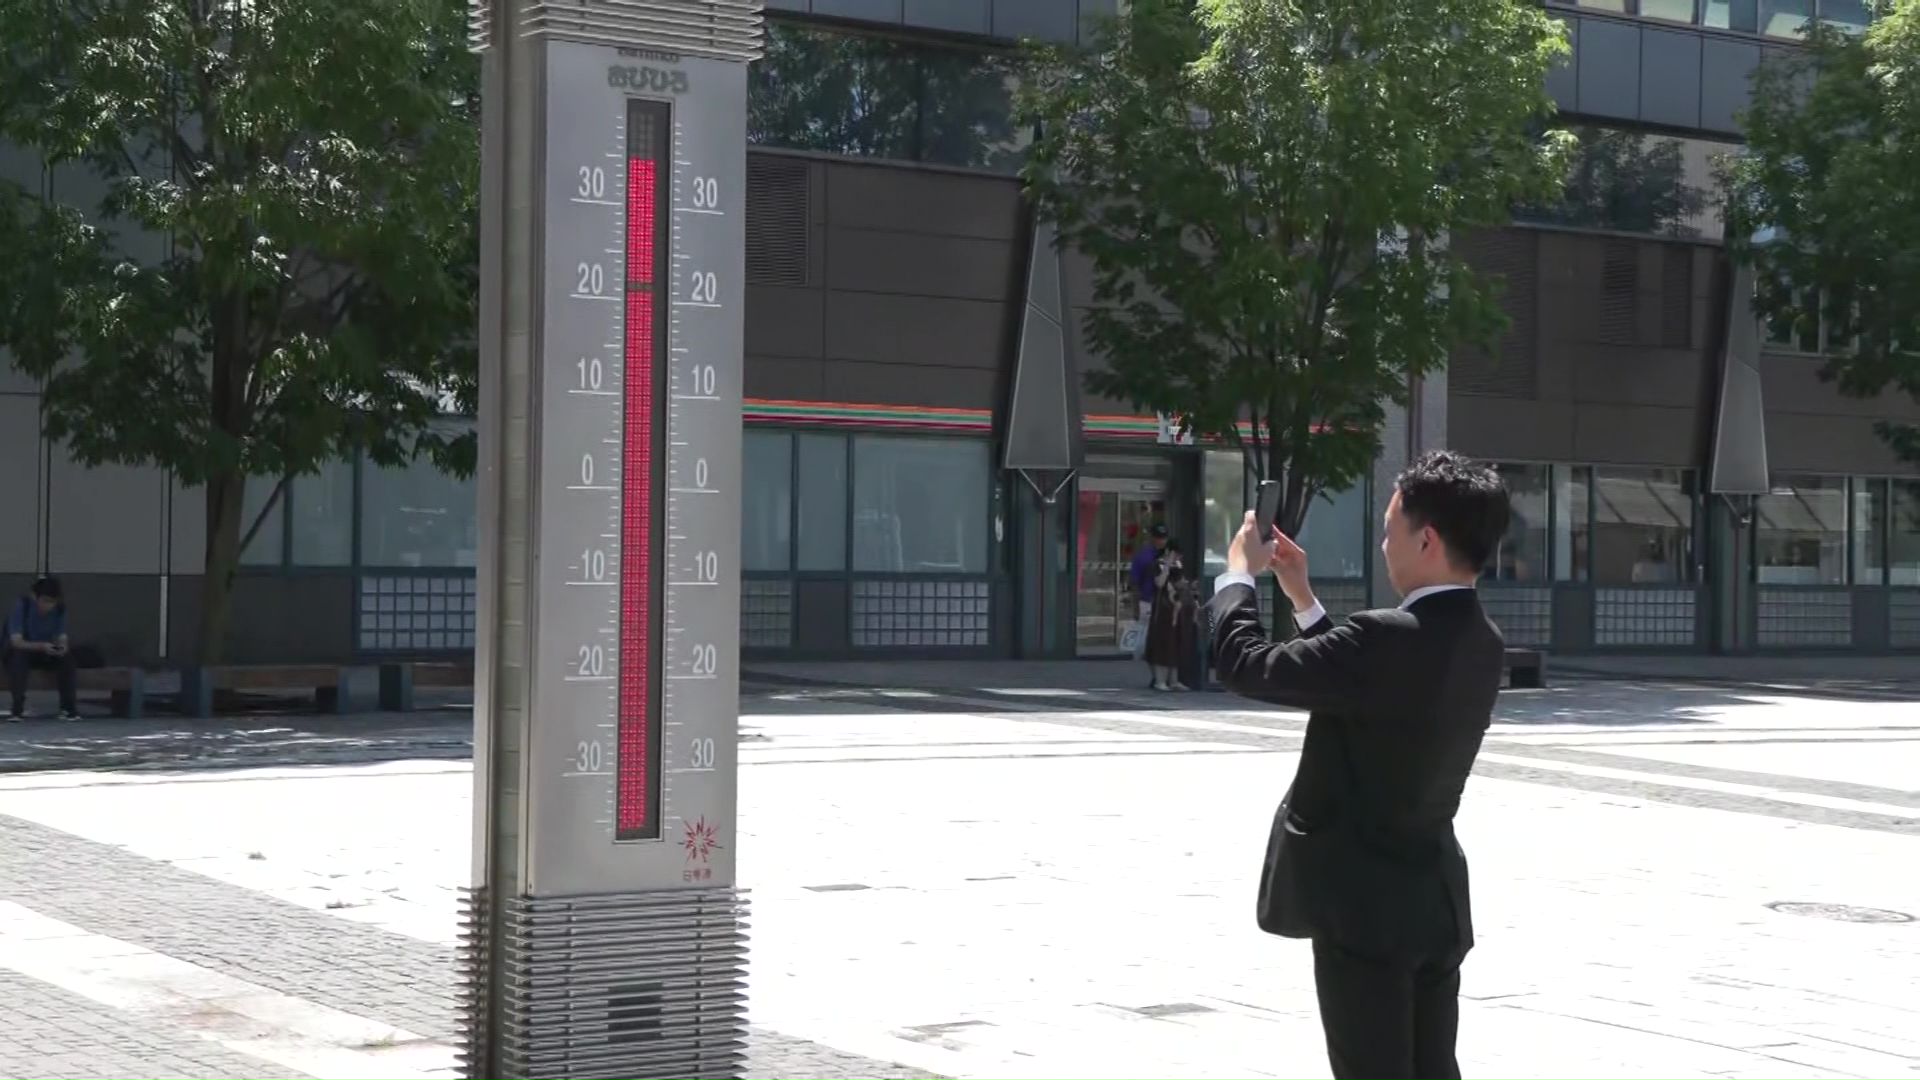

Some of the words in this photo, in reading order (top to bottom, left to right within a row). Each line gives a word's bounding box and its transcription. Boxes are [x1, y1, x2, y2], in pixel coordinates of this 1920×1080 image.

[578, 166, 604, 197] 30
[693, 177, 718, 208] 30
[577, 262, 603, 294] 20
[691, 271, 716, 302] 20
[577, 357, 602, 389] 10
[692, 364, 715, 395] 10
[582, 454, 593, 485] 0
[696, 458, 708, 488] 0
[568, 549, 605, 580] -10
[682, 551, 717, 581] -10
[567, 645, 603, 676] -20
[565, 740, 601, 772] -30
